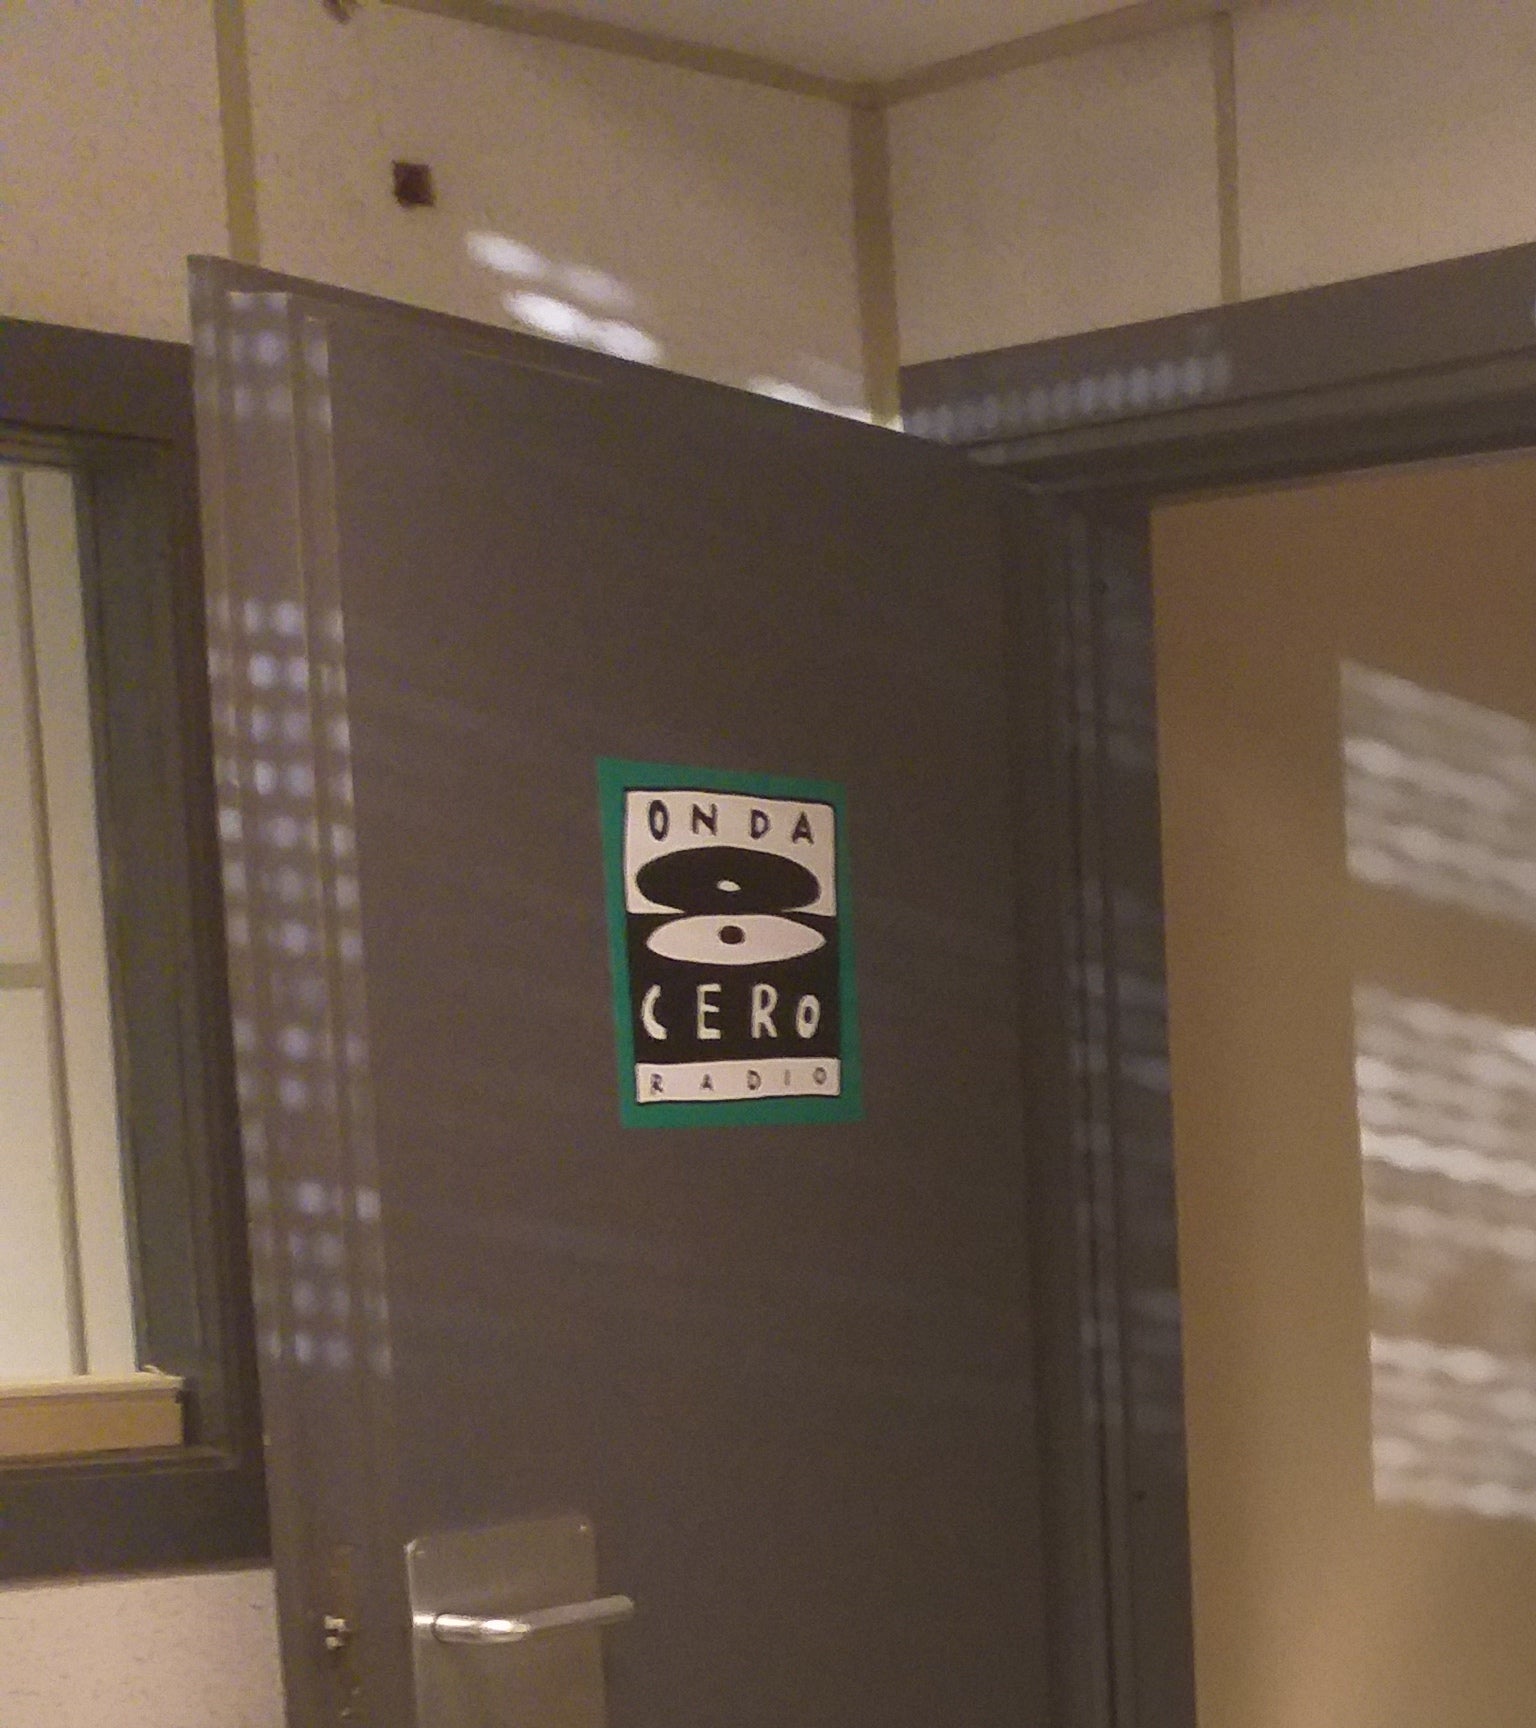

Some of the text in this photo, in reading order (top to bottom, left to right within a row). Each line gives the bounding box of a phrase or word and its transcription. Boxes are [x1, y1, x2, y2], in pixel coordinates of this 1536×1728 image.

[648, 799, 815, 845] ONDA
[640, 983, 821, 1041] CERO
[649, 1065, 829, 1095] RADIO
